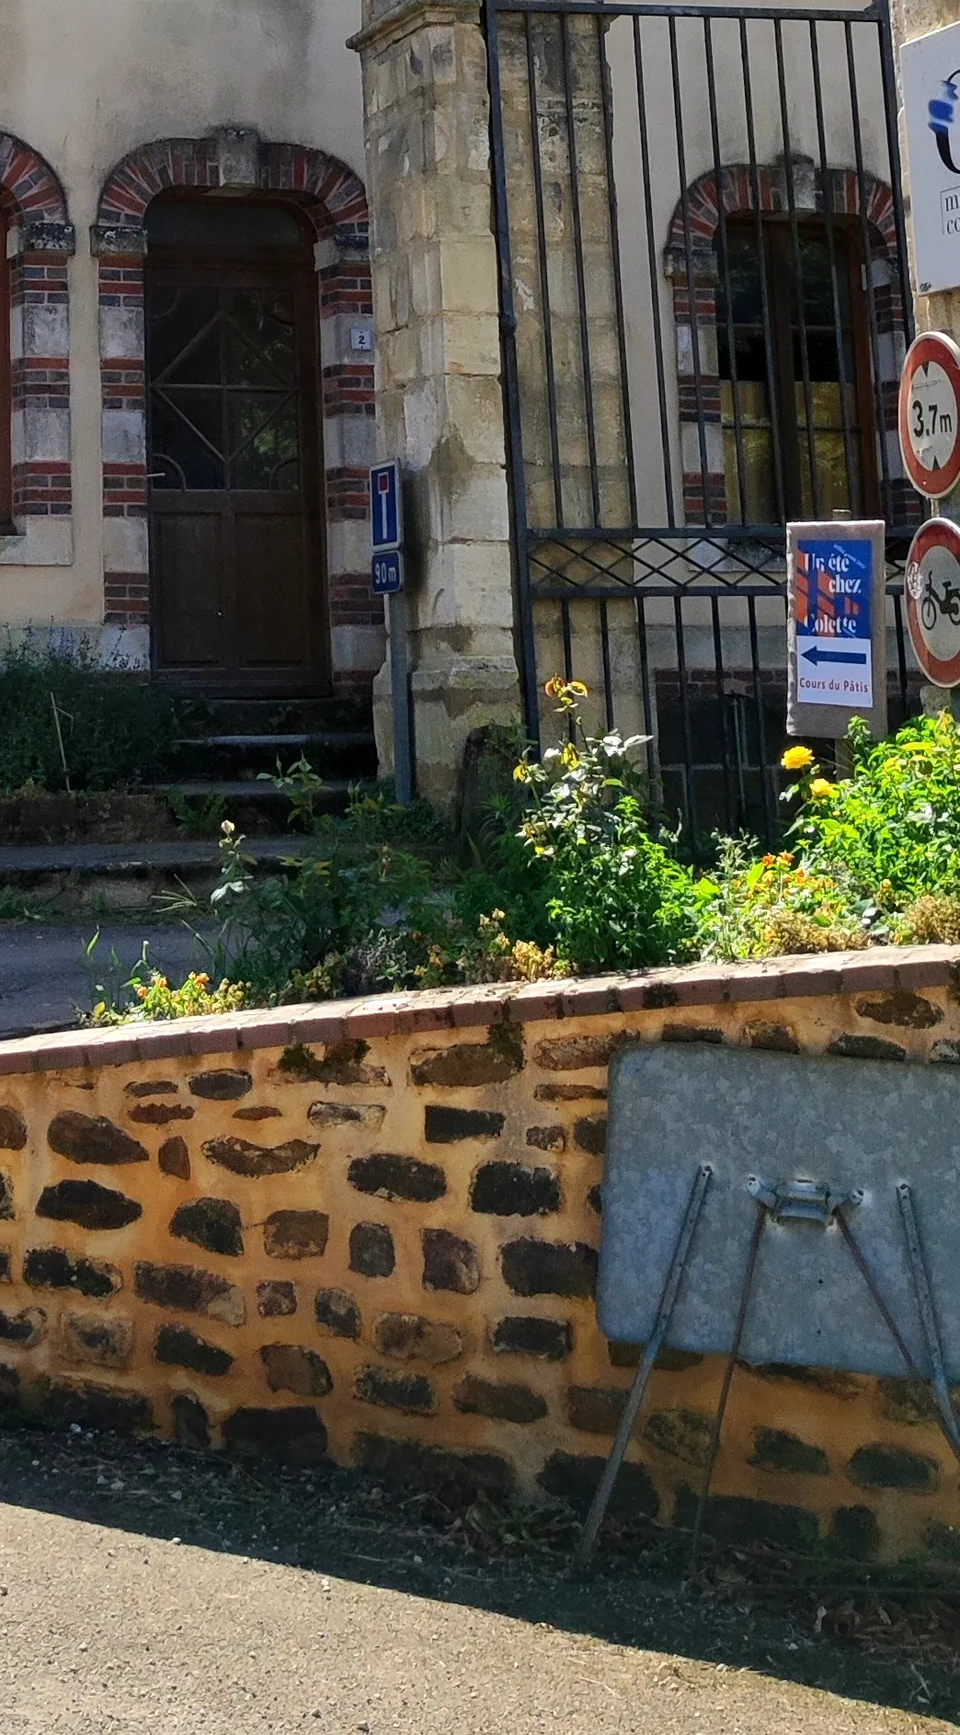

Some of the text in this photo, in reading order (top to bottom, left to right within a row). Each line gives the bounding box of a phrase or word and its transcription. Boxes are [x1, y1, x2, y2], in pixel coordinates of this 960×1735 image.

[358, 334, 367, 345] 2
[804, 553, 826, 573] Un
[828, 552, 850, 573] été
[828, 573, 862, 594] chez
[803, 613, 857, 635] Colette
[799, 677, 869, 693] Cours du Pâtis
